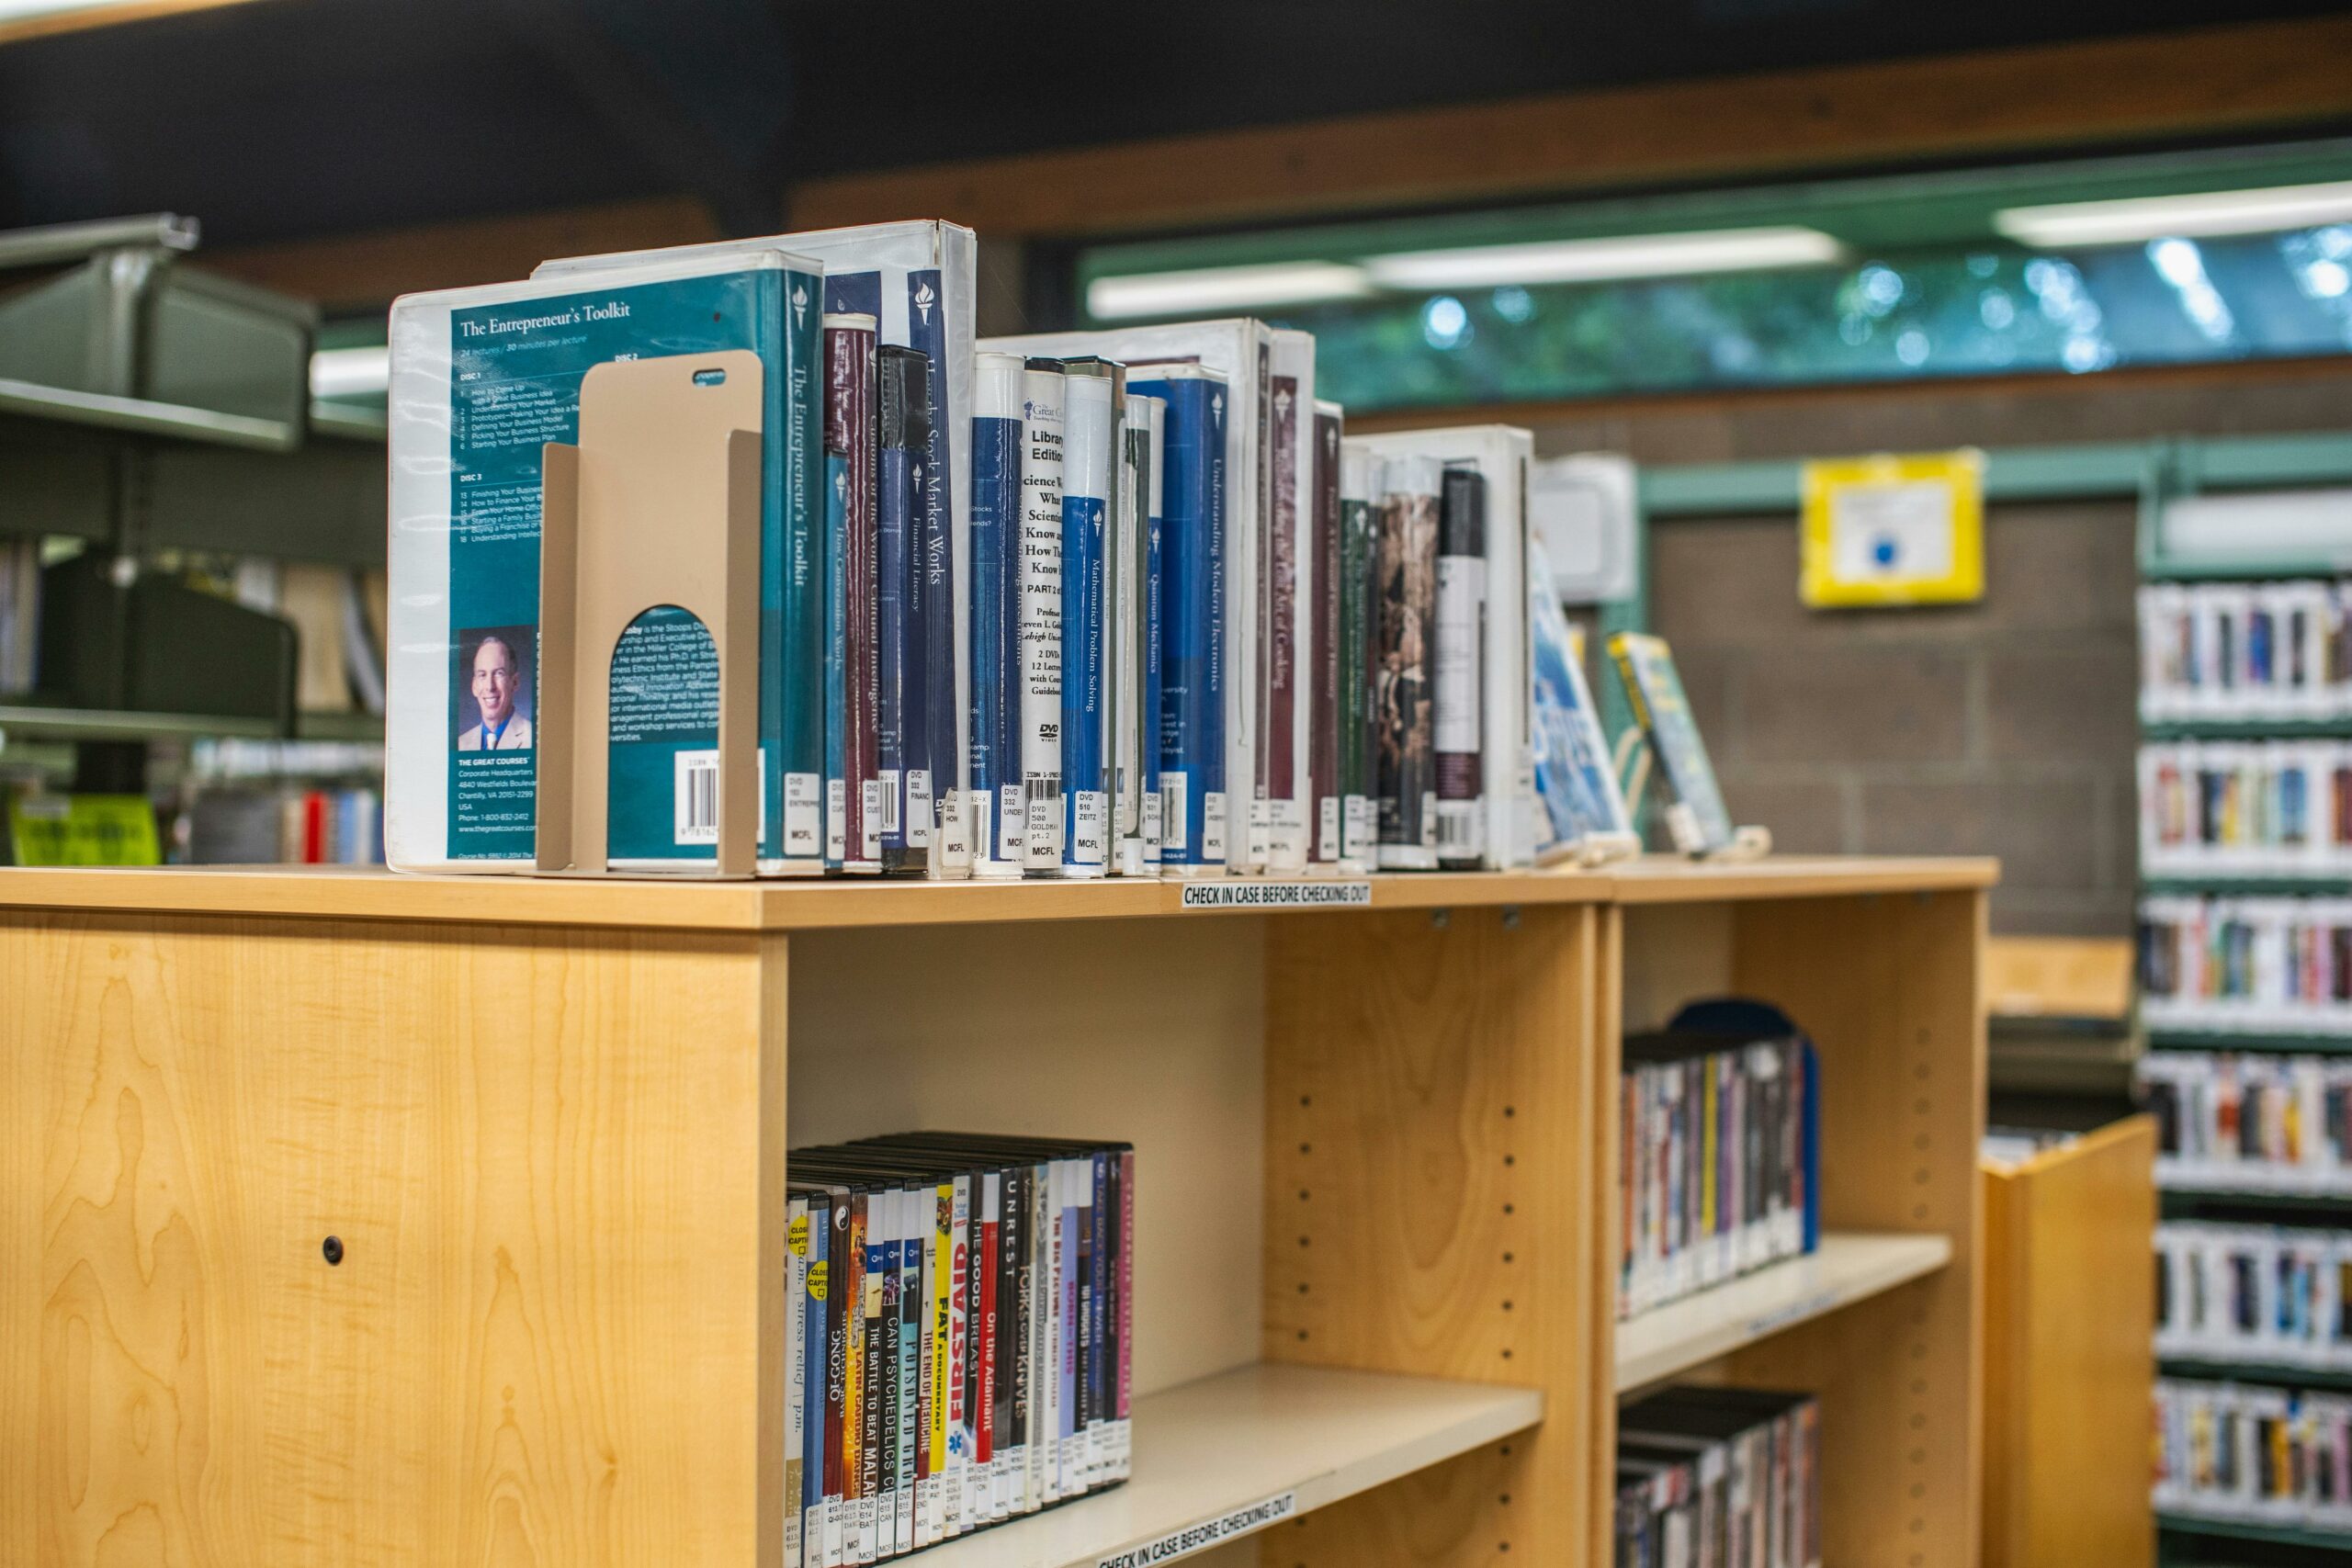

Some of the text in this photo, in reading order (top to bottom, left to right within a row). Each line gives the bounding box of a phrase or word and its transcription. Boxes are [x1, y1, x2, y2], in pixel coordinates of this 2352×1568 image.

[460, 301, 632, 337] The Entrepreneur's Toolkit
[506, 343, 517, 352] 30
[518, 340, 547, 350] minutes
[460, 373, 477, 381] DISC
[510, 392, 538, 401] Business
[534, 398, 557, 407] Market
[1033, 404, 1055, 417] Great
[471, 415, 563, 432] Defining Business Model
[471, 424, 571, 441] Picking Business Structure
[471, 434, 557, 449] Starting Business Plan
[1032, 430, 1063, 449] Library
[460, 474, 476, 482] DISC
[790, 365, 808, 587] The Entrepreneur's Toolkit
[1022, 474, 1056, 487] cience
[471, 490, 500, 499] Finishing
[495, 497, 520, 505] Finance
[928, 429, 946, 586] Stock Market Works
[471, 516, 497, 525] Starting
[501, 523, 529, 532] Franchise
[1025, 526, 1056, 540] Know
[471, 532, 517, 543] Understanding
[1024, 544, 1052, 557] How
[910, 516, 922, 613] Financial Literacy
[1031, 561, 1057, 575] Know
[1209, 458, 1222, 693] Understanding Modern Electronics
[1027, 583, 1052, 594] PART
[835, 526, 844, 671] How Conversation Works
[870, 584, 879, 645] Cultural
[1148, 573, 1159, 674] Quantum Mechanics
[661, 632, 696, 642] Executive
[1085, 558, 1101, 713] Mathematical Problem Solving
[668, 642, 697, 652] College
[630, 654, 657, 663] earned
[1272, 632, 1290, 690] Cooking
[632, 663, 656, 673] Ethics
[1032, 661, 1042, 671] 12
[650, 672, 682, 681] Institute
[1029, 673, 1047, 682] with
[868, 649, 879, 735] Intelligence
[621, 701, 694, 713] international media
[653, 711, 699, 721] professional
[628, 720, 696, 733] workshop services
[1039, 724, 1059, 733] DVD
[472, 757, 495, 766] GREAT
[496, 756, 528, 765] COURSES
[458, 768, 534, 779] Corporate Headquarters
[476, 779, 509, 788] Westfields
[1004, 788, 1019, 796] DVD
[458, 803, 473, 811] USA
[946, 815, 958, 823] HOW
[1079, 813, 1097, 821] ZEITZ
[792, 829, 813, 840] MCFL
[1031, 832, 1050, 840] pt.2
[948, 843, 965, 852] MCFL
[1077, 839, 1099, 850] MCFL
[1032, 847, 1056, 856] MCFL
[1184, 885, 1369, 905] CHECK IN CASE BEFORE CHECKING OUT
[1005, 1179, 1017, 1278] UNREST
[969, 1217, 982, 1380] THE GOOD BREAST
[796, 1301, 806, 1342] stress
[938, 1296, 949, 1342] FAT
[869, 1326, 880, 1348] THE
[950, 1243, 968, 1422] FIRST AID
[794, 1349, 805, 1385] relief
[830, 1329, 842, 1402] QI-GONG
[868, 1351, 879, 1393] BATTLE
[983, 1312, 996, 1432] On the Adamant
[904, 1341, 918, 1436] POISONED
[920, 1330, 933, 1455] THE END OF MEDICINE
[1014, 1354, 1030, 1419] KNIVES
[884, 1316, 899, 1471] CAN PSYCHEDELICS
[867, 1395, 877, 1410] TO
[793, 1404, 804, 1434] p.m.
[853, 1350, 863, 1498] LATIN CARDIO DANCE
[866, 1414, 877, 1442] BEAT
[860, 1501, 875, 1510] DVD
[879, 1495, 893, 1504] DVD
[1098, 1495, 1293, 1568] CHECK IN CASE BEFORE CHECKING OUT
[858, 1551, 875, 1560] MCFL
